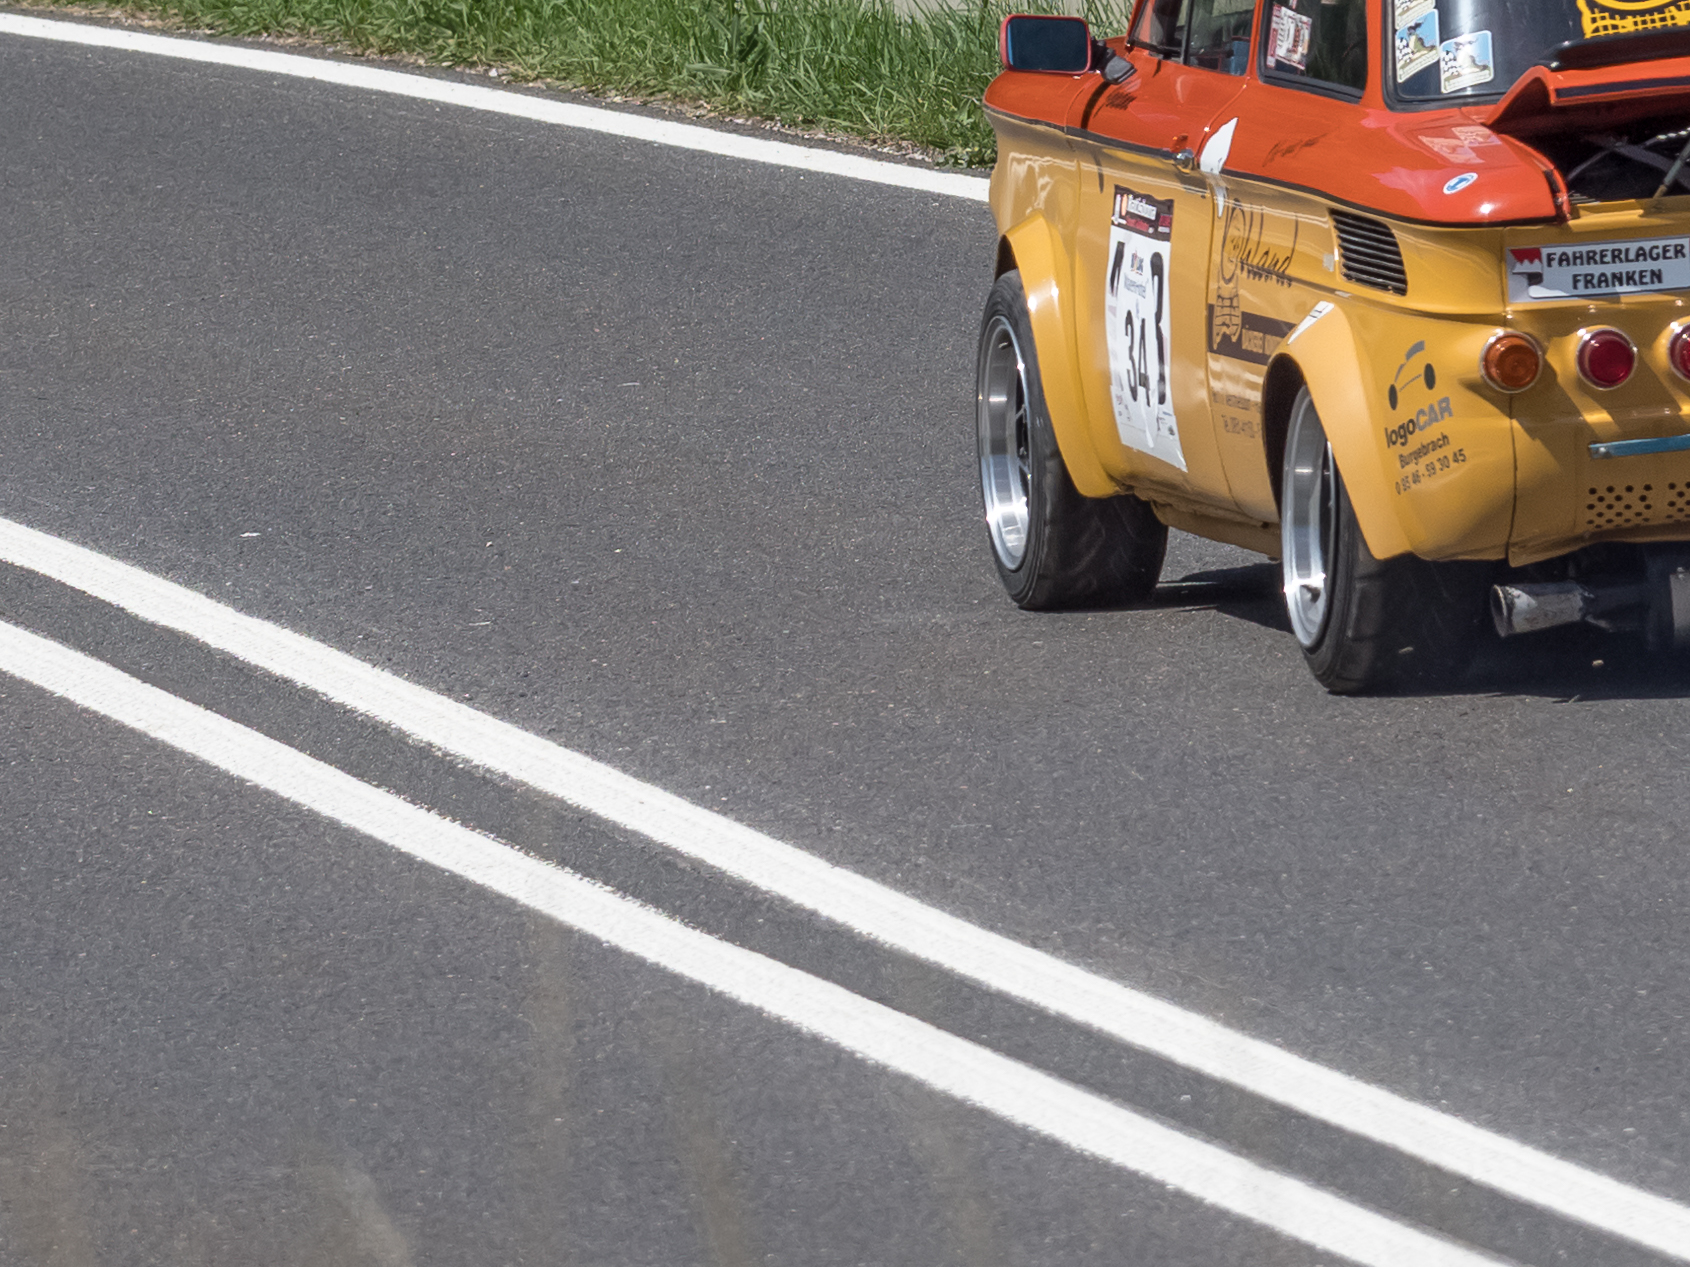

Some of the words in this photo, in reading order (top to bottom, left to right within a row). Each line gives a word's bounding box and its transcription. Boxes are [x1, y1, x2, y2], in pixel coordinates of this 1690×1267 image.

[1545, 243, 1687, 268] FAHRERLAGER
[1572, 268, 1664, 291] FRANKEN
[1124, 309, 1151, 408] 34
[1384, 396, 1454, 449] logoCAR
[1452, 448, 1467, 464] 45
